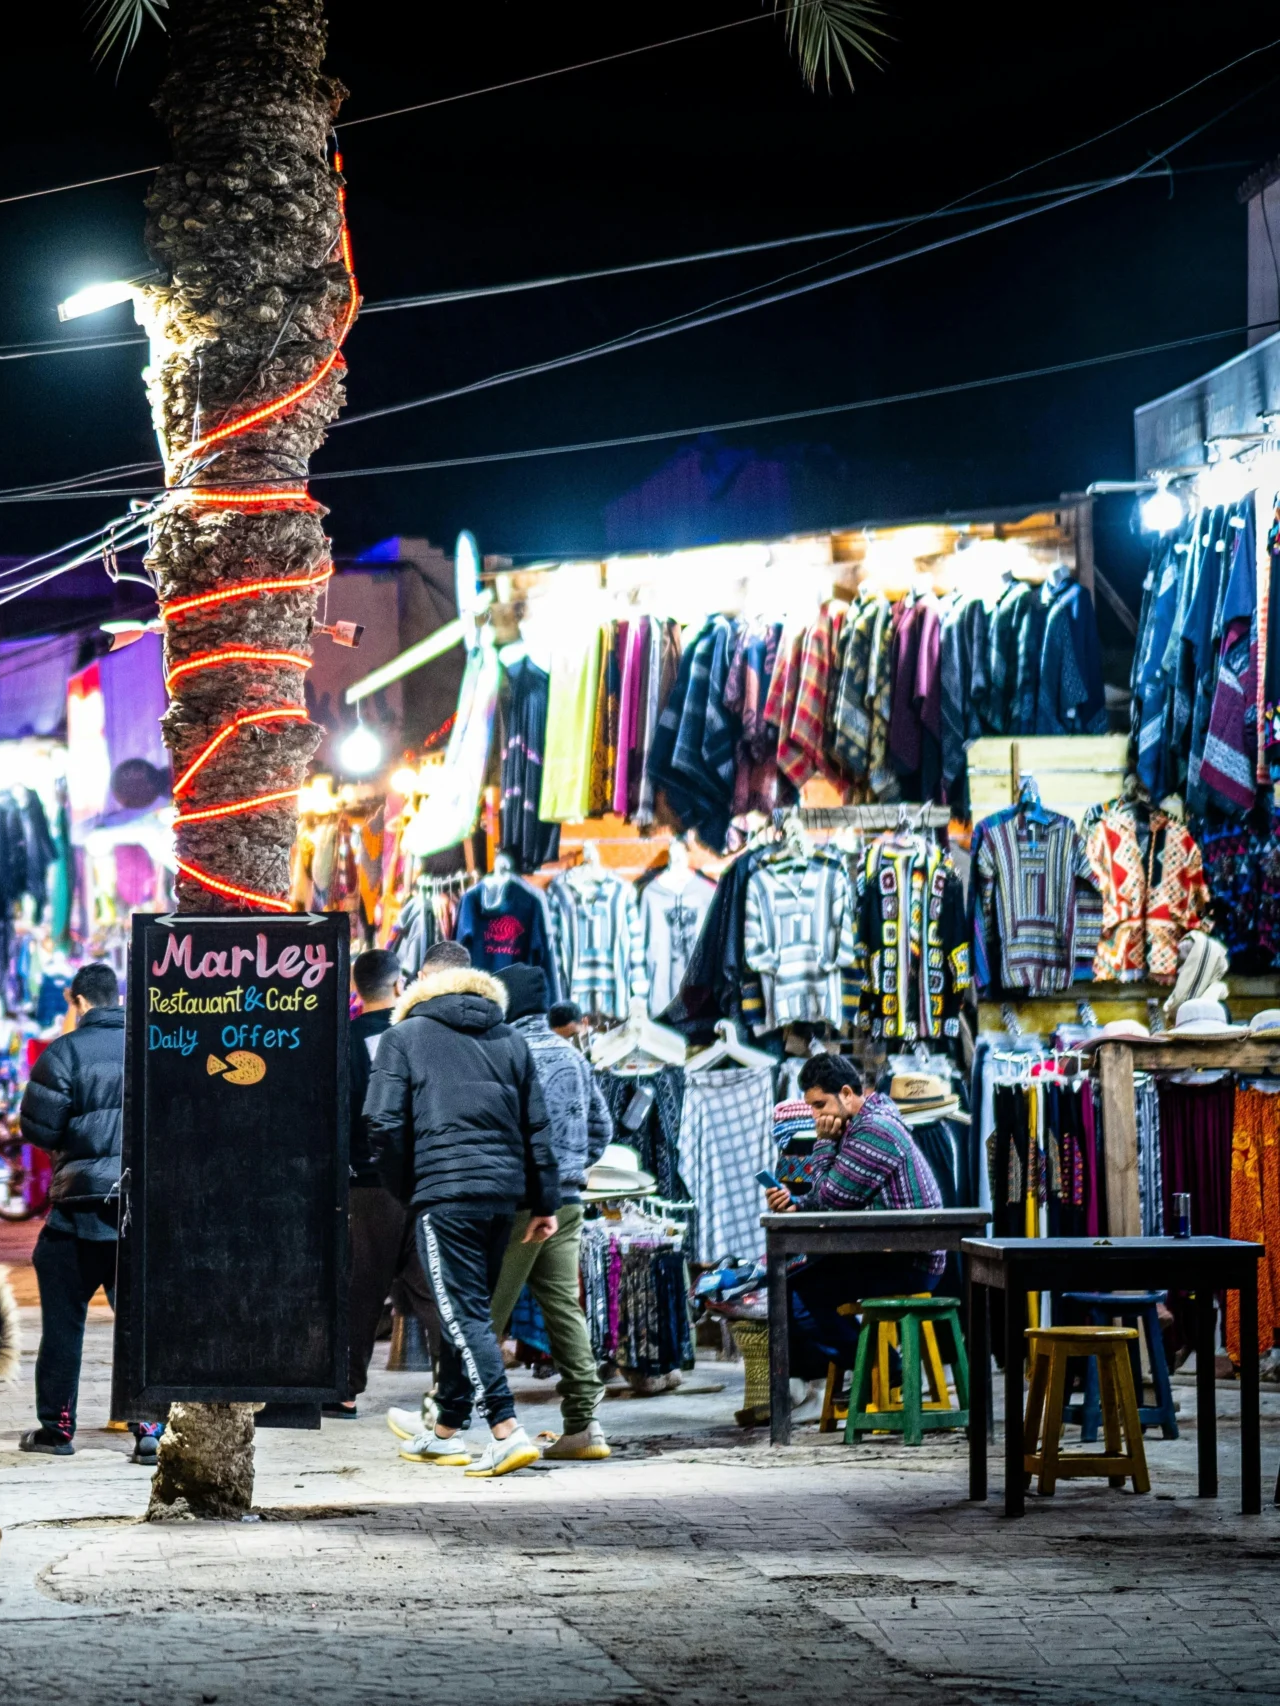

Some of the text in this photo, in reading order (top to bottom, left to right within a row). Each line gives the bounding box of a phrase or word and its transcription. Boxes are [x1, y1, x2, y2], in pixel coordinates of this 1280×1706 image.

[151, 932, 335, 989] Marley
[244, 985, 265, 1012] &
[266, 986, 319, 1012] Cafe
[148, 1024, 301, 1057] Daily Offers
